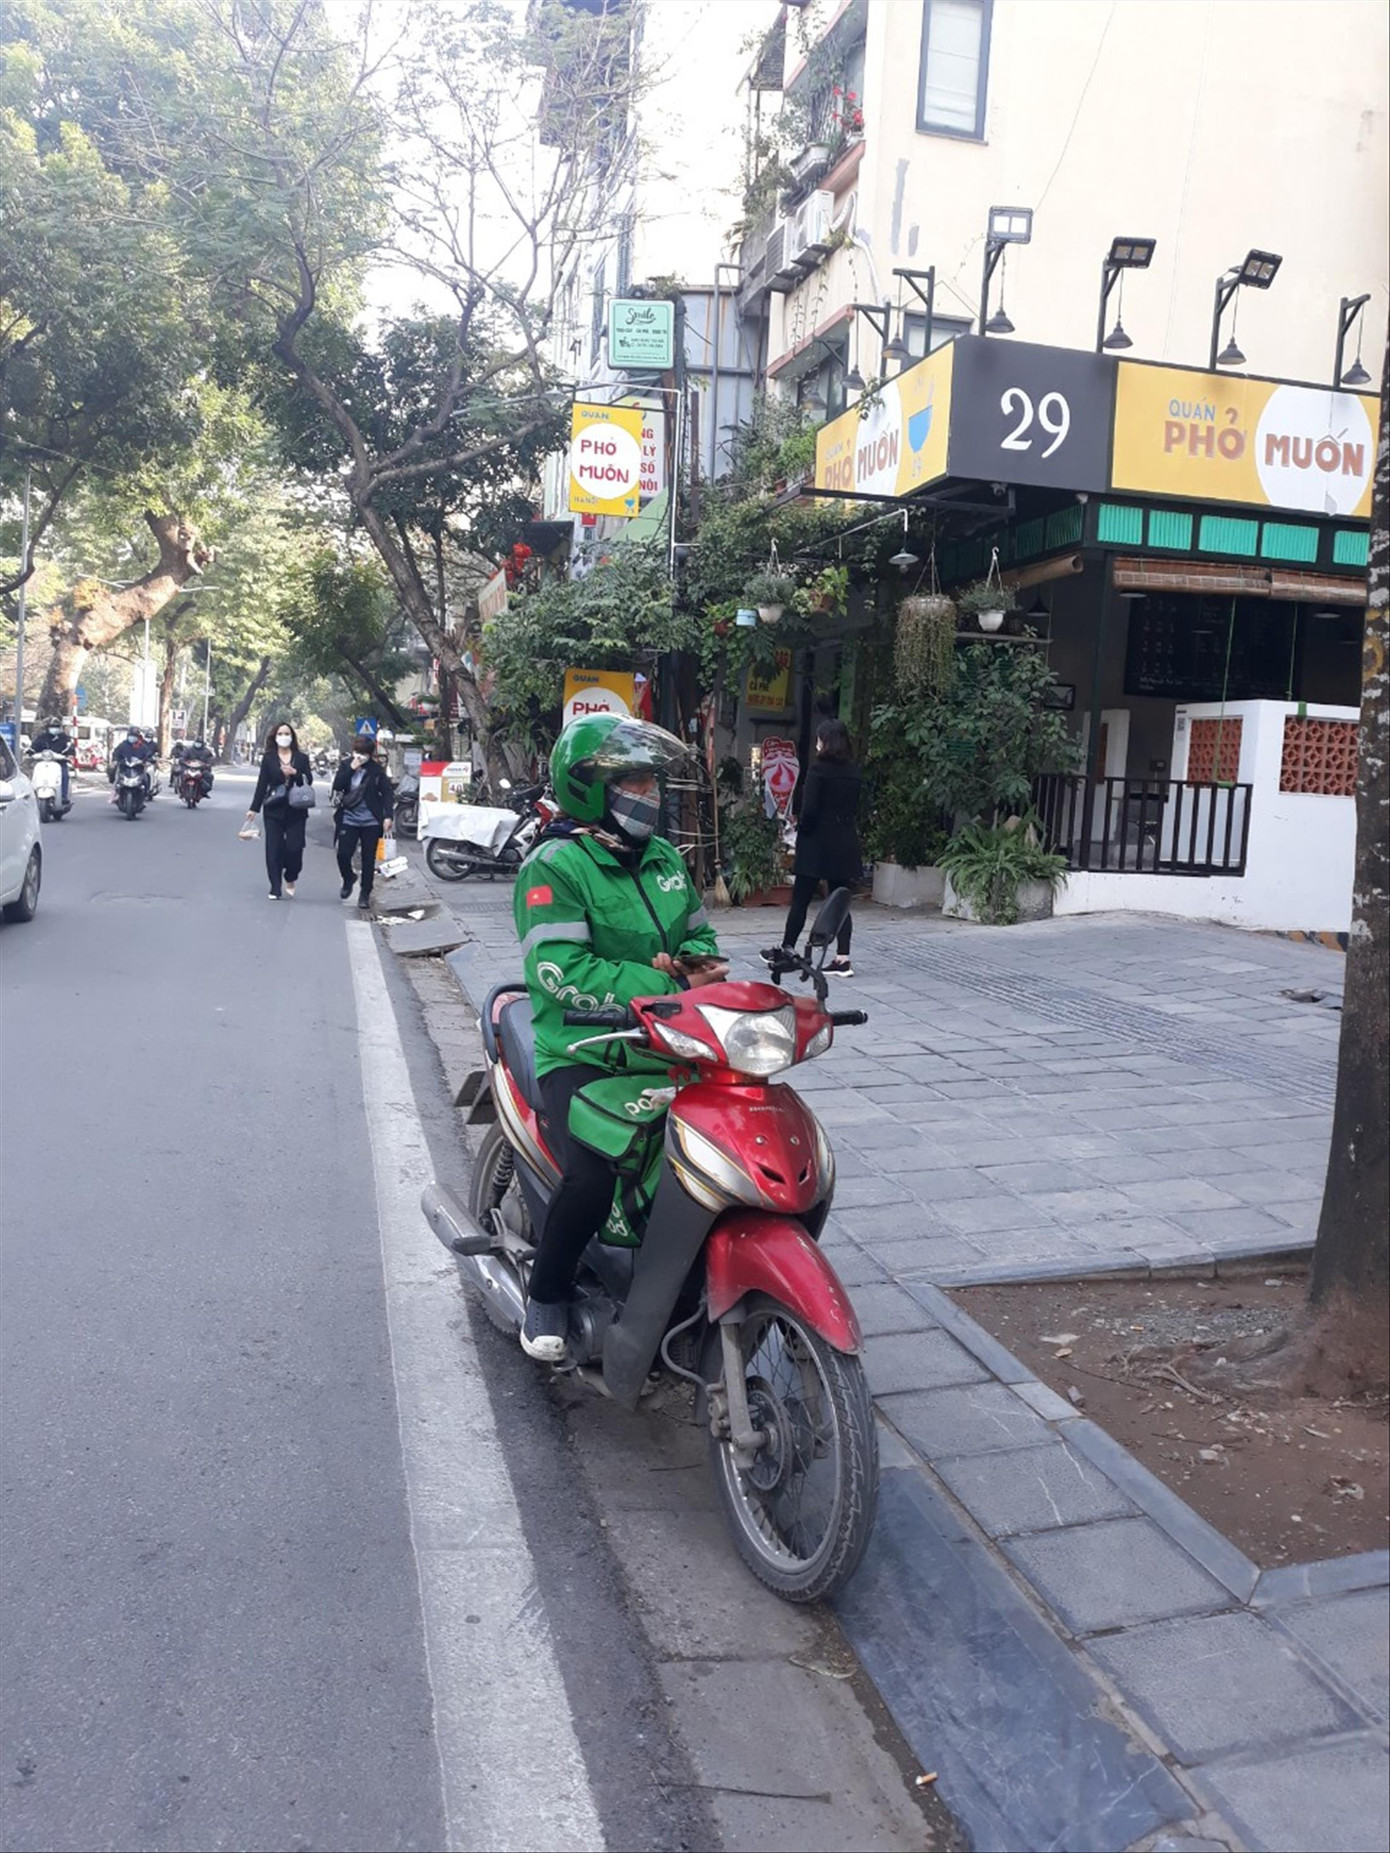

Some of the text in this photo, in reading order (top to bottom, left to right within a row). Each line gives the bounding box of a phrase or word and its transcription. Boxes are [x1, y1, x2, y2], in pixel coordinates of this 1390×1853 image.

[625, 307, 657, 325] Smile
[1000, 387, 1071, 459] 29
[1168, 397, 1217, 422] QUÁN
[1163, 407, 1365, 477] PHỞ MUỐN
